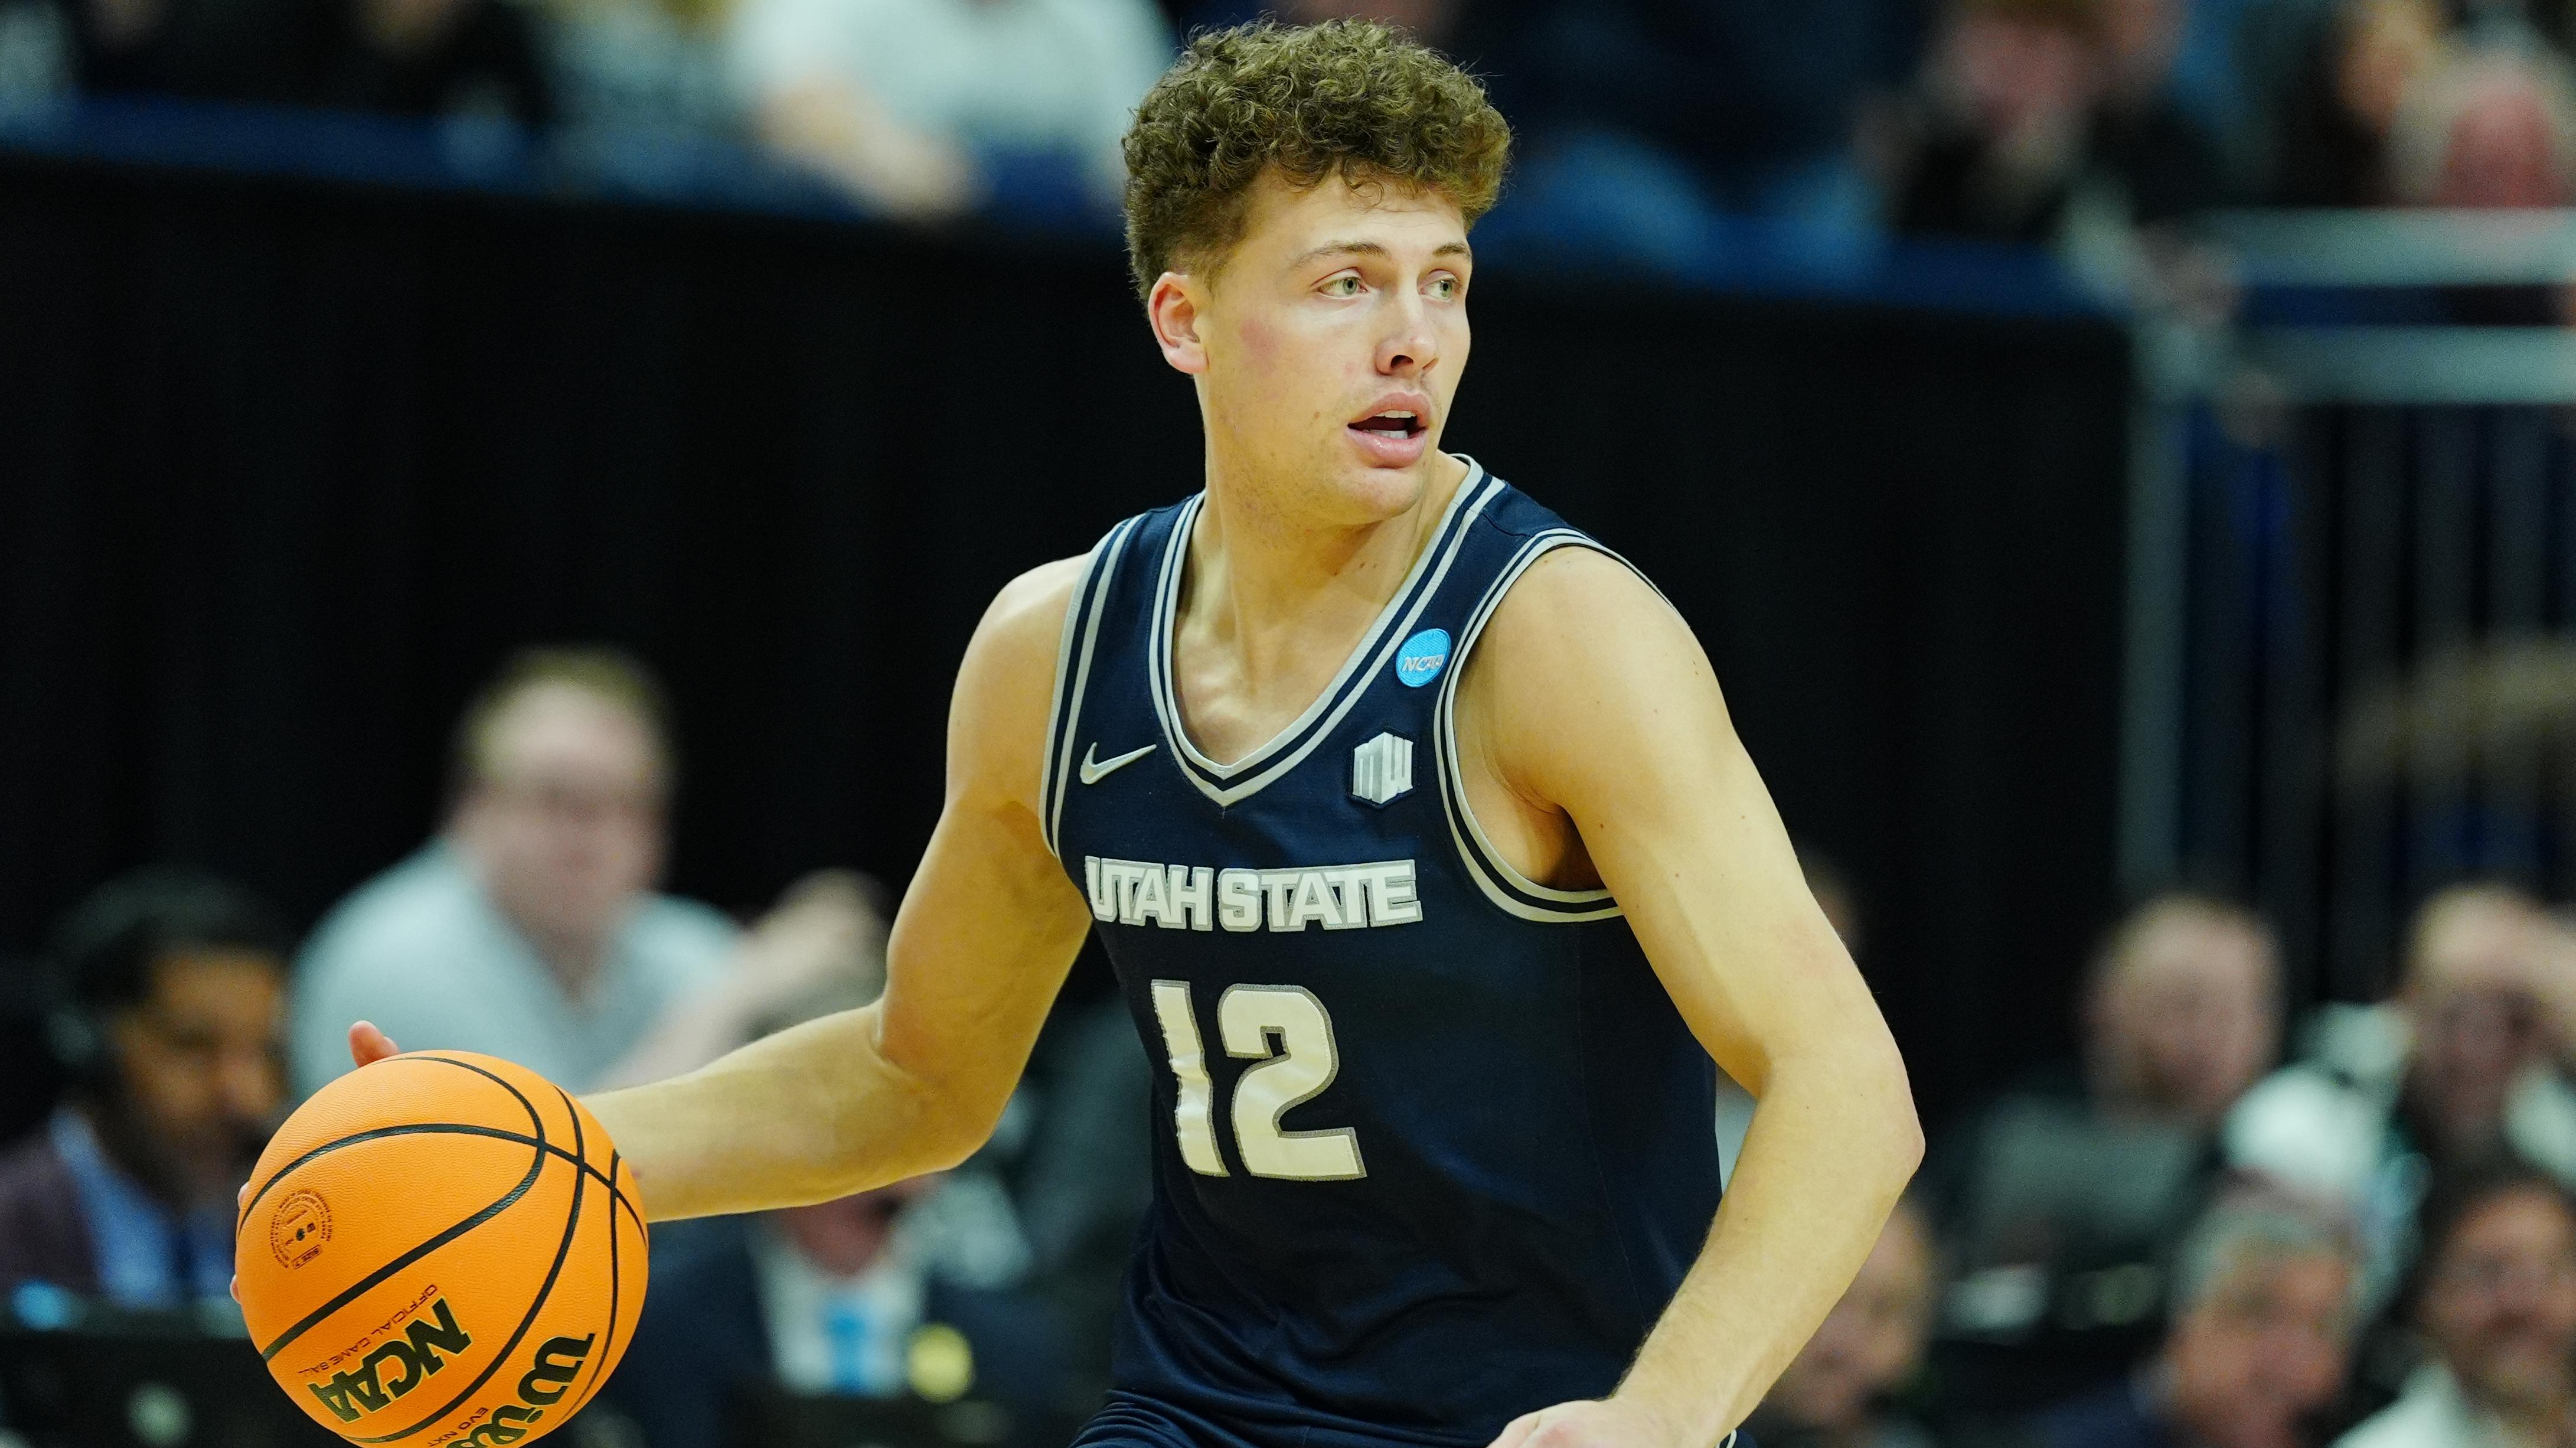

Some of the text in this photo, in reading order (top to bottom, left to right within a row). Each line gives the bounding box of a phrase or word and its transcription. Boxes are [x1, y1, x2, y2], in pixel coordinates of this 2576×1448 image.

[1402, 654, 1444, 672] NCAA
[1085, 855, 1424, 932] UTAH STATE
[1151, 979, 1368, 1182] 12
[298, 1284, 438, 1374] OFFICIAL GAME BALL
[306, 1294, 473, 1424] NCAA
[427, 1407, 489, 1447] EVO NXT
